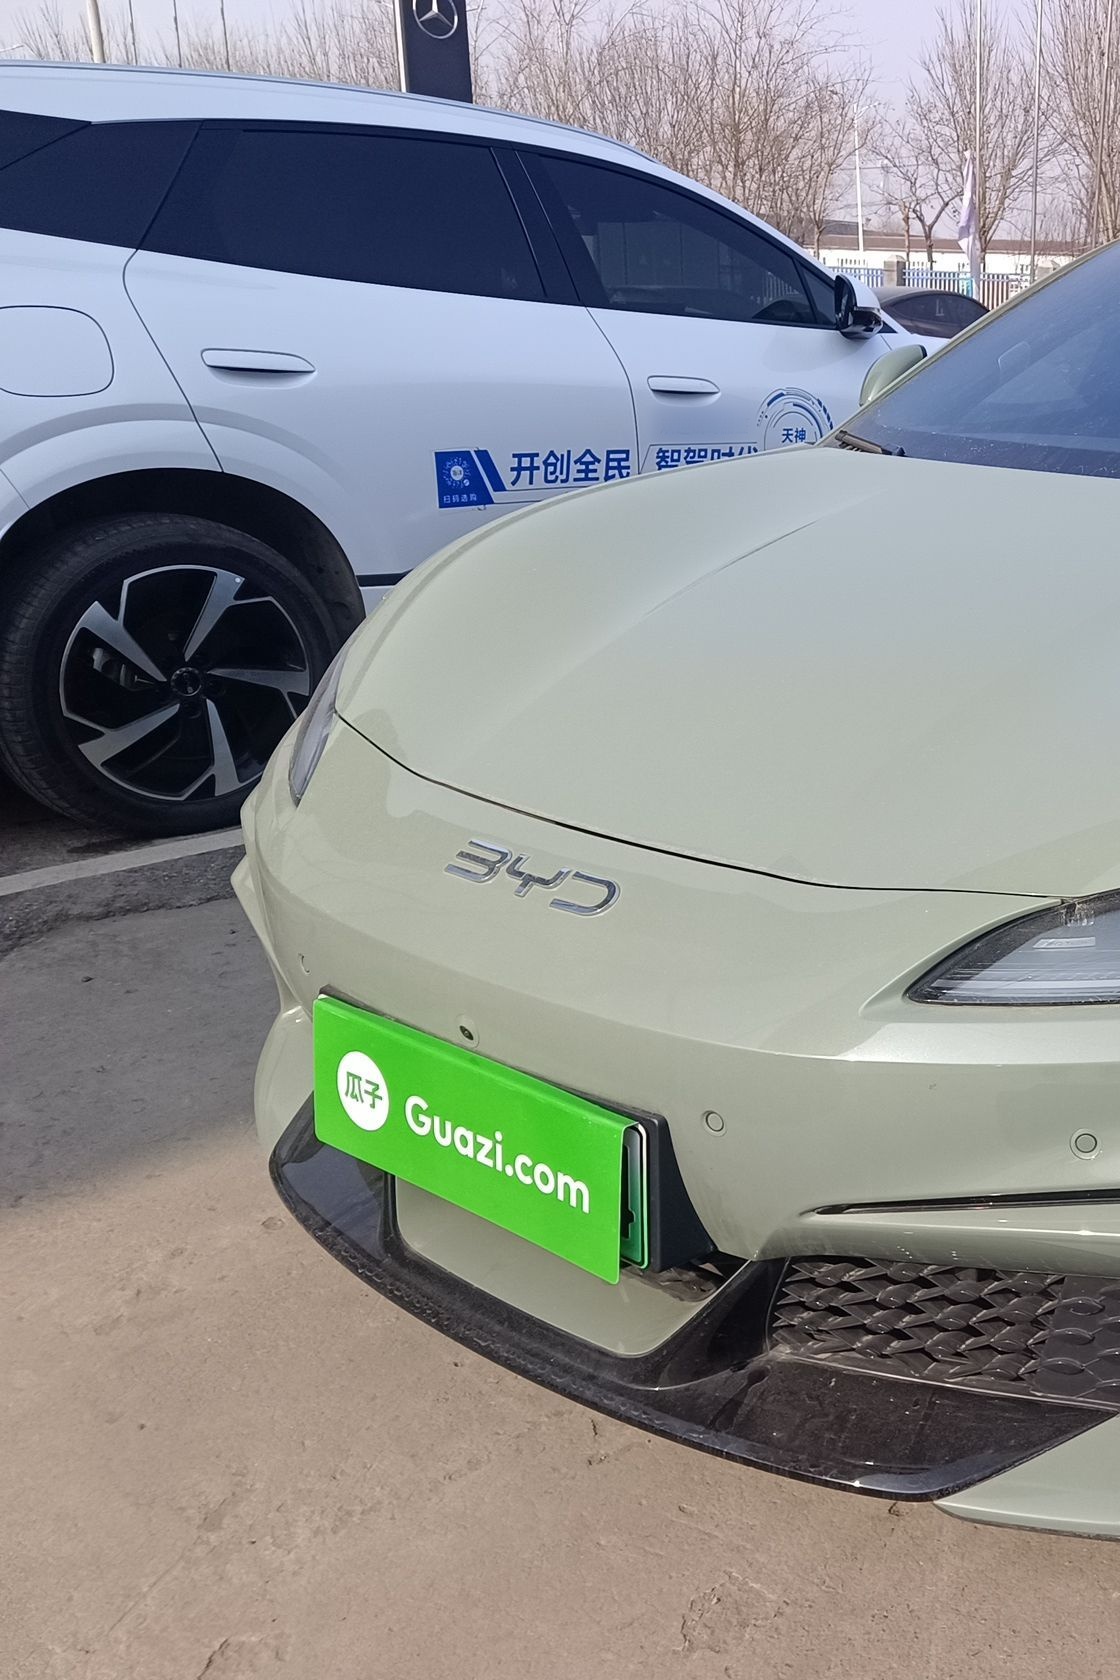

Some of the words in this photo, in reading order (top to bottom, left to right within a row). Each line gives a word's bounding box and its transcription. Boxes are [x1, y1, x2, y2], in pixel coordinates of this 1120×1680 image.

[781, 427, 807, 444] 天神
[510, 448, 631, 486] 开创全民
[443, 838, 621, 917] BYD
[344, 1071, 383, 1110] 瓜子
[404, 1095, 591, 1214] Guazi.com
